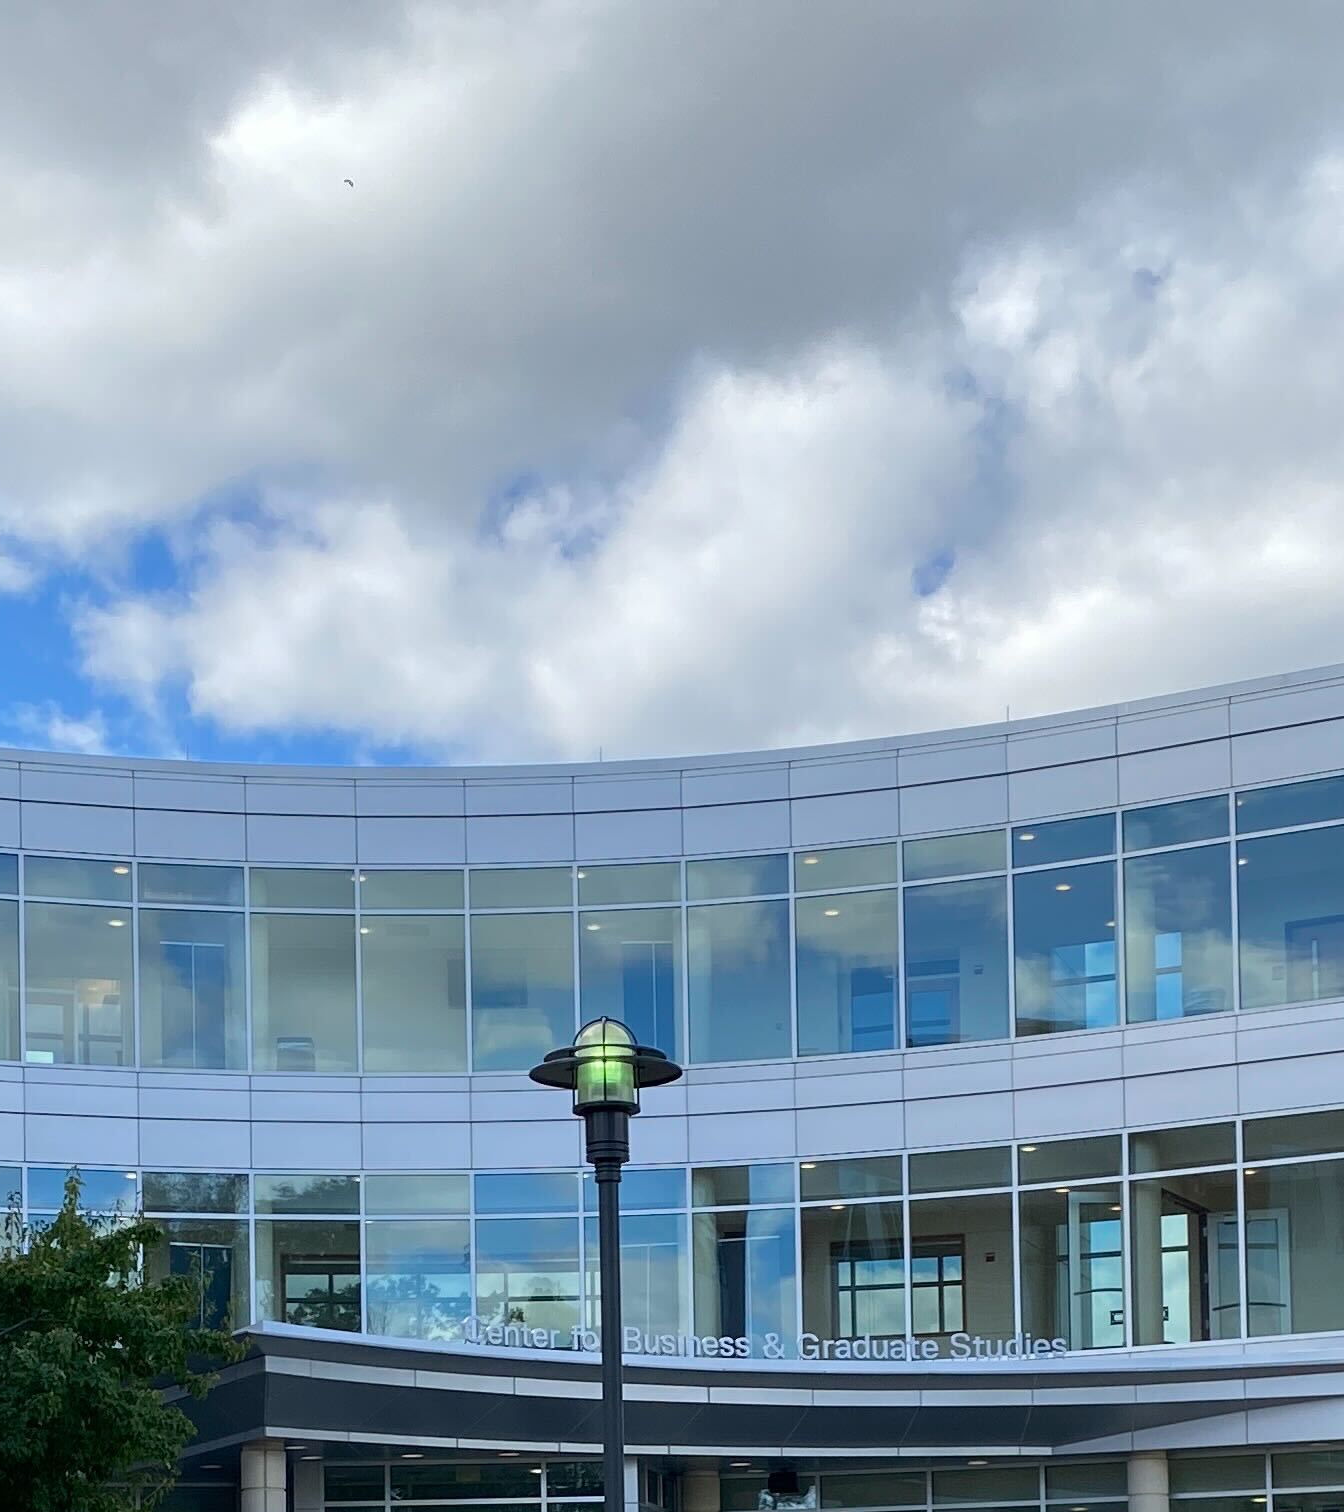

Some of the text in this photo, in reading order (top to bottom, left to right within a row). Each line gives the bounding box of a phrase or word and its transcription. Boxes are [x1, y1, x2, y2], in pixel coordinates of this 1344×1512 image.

[462, 1316, 1067, 1360] Center fo Business & Graduate Studies
